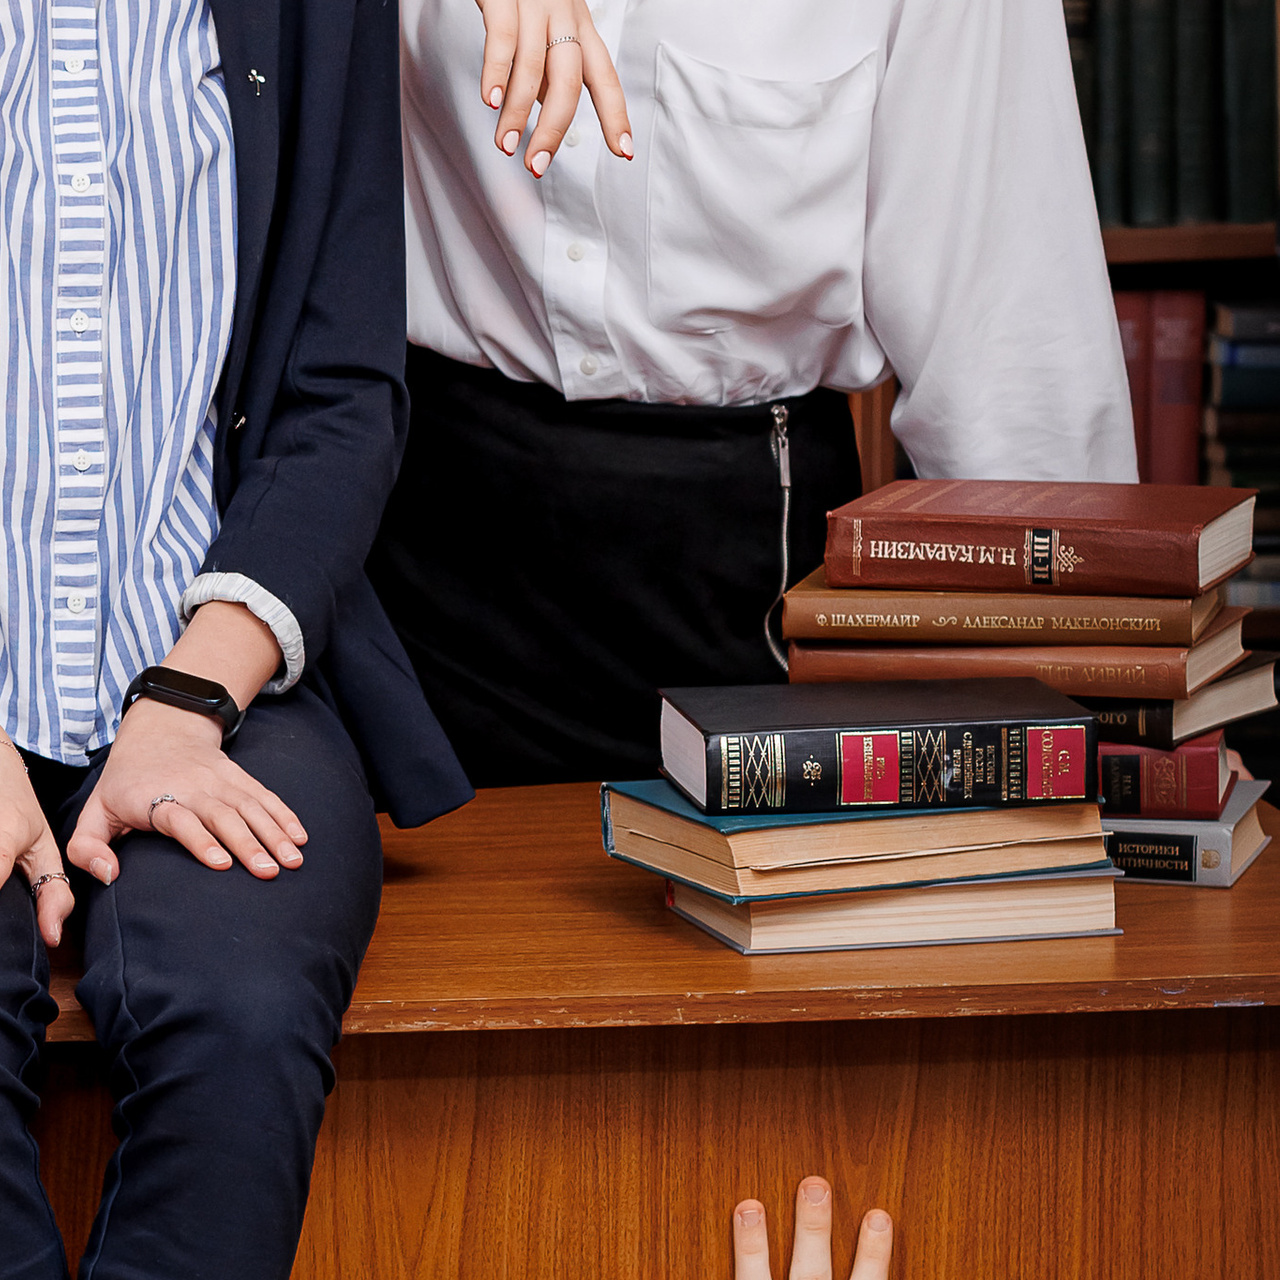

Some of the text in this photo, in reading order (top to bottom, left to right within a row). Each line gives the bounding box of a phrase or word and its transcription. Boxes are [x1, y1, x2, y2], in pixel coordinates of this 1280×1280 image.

[962, 616, 1046, 629] АЛЕКСАНДР
[1051, 616, 1162, 632] МАКЕДОНСКИЙ
[1036, 664, 1147, 684] ТИТ ЛИВИЙ
[1118, 842, 1180, 856] ИСТОРИКИ
